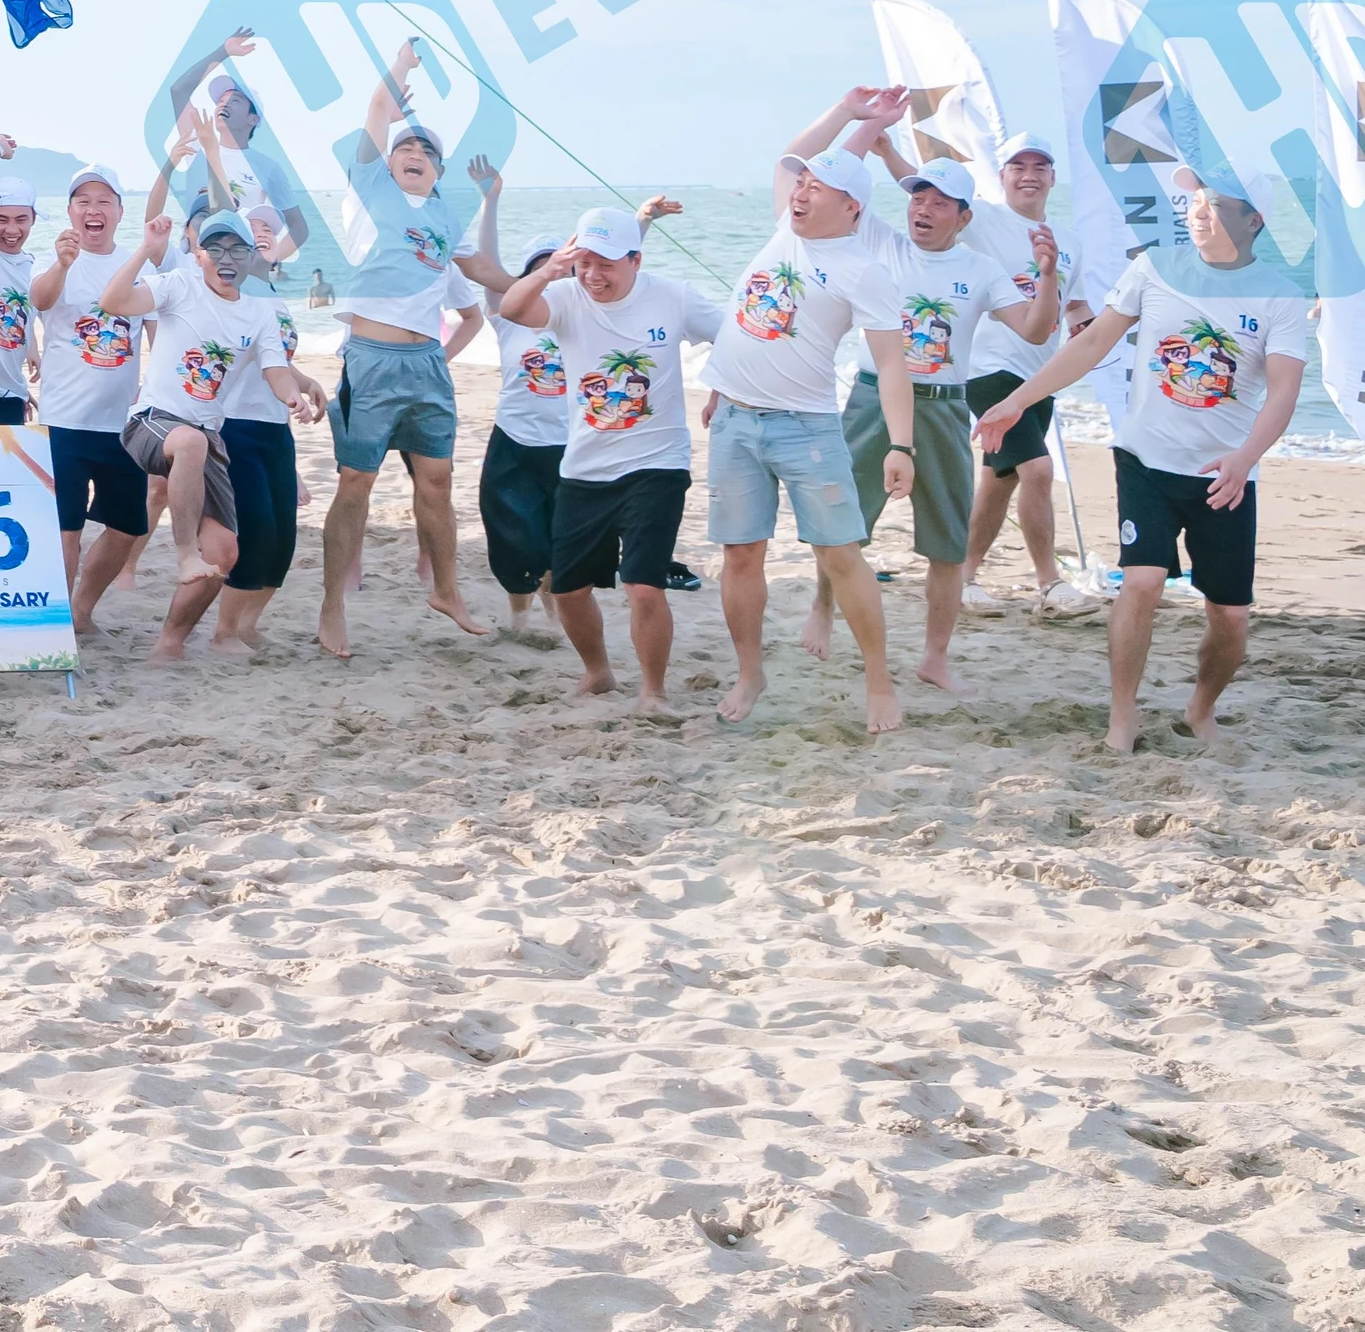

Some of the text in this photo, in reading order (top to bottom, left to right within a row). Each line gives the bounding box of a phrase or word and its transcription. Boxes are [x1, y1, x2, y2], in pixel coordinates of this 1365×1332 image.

[1171, 194, 1191, 246] RIALS
[1059, 251, 1071, 265] 16
[952, 282, 968, 294] 16
[1239, 315, 1258, 332] 16
[648, 327, 666, 341] 16
